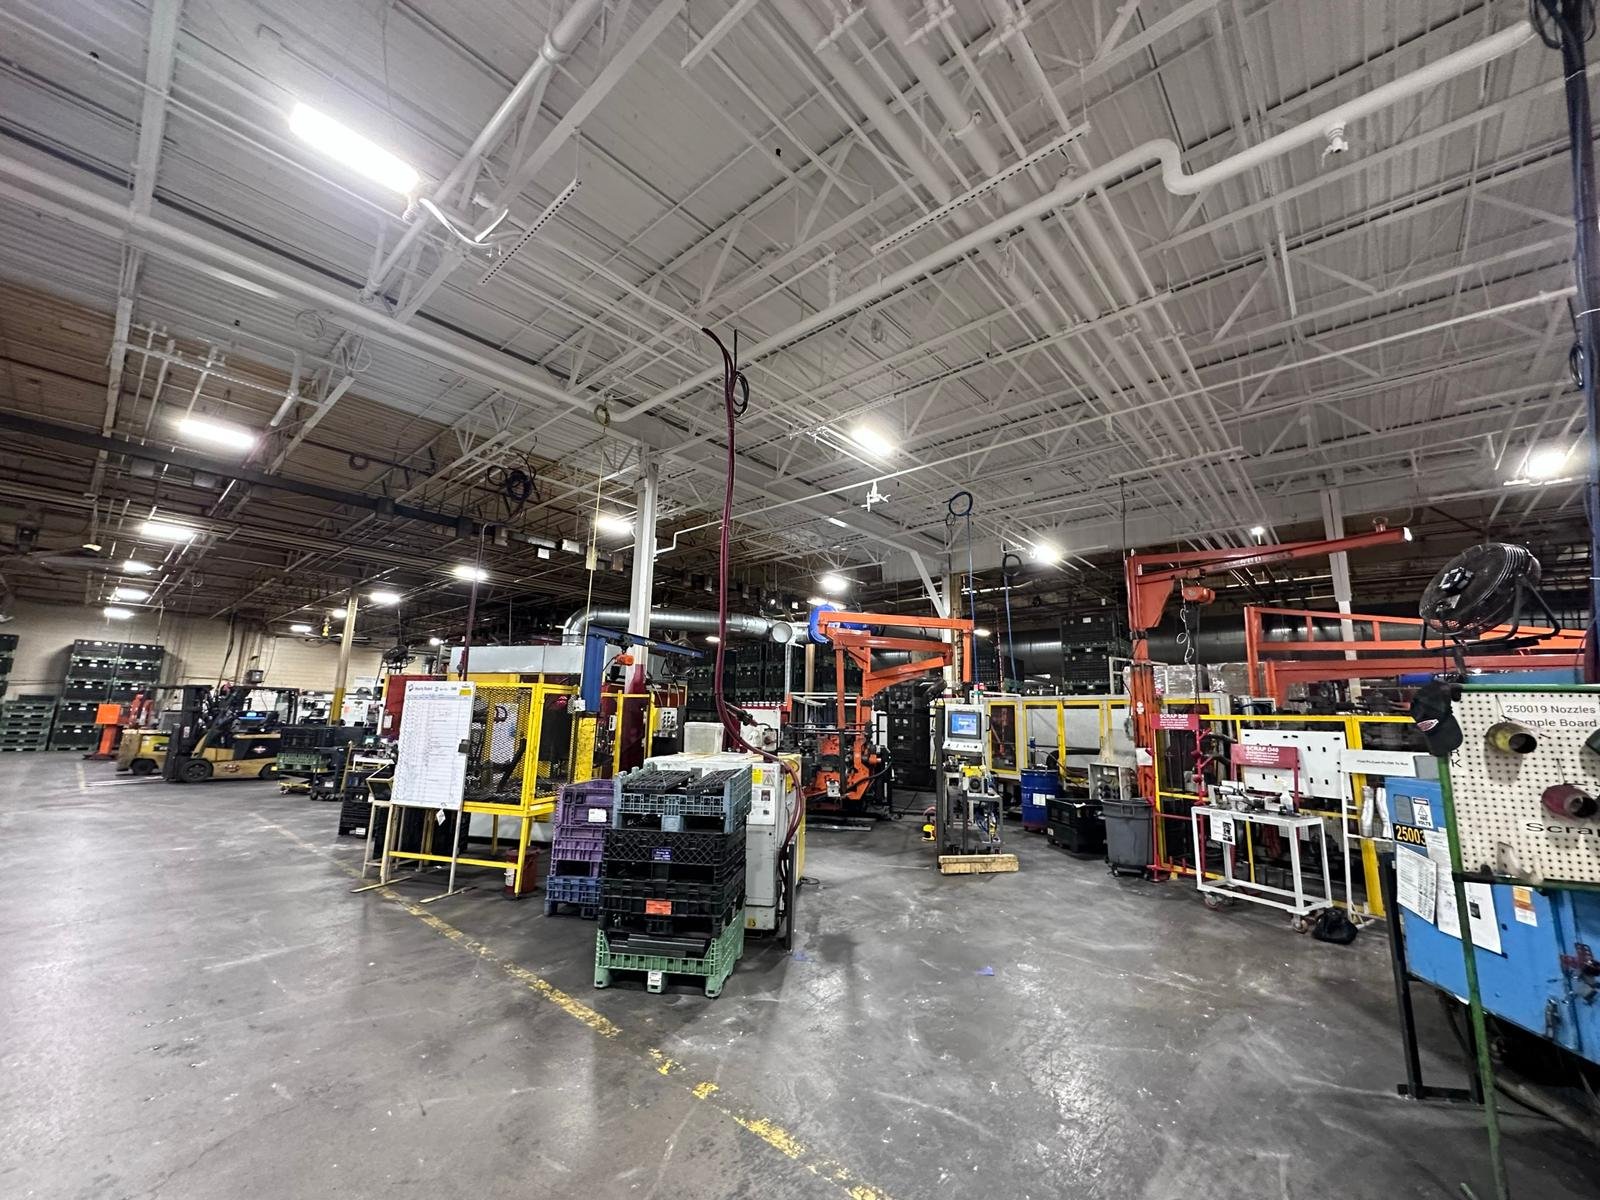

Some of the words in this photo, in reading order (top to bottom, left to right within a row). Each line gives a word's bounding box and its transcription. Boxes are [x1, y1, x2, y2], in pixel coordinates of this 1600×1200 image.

[1505, 705, 1548, 714] 250019
[1550, 705, 1597, 714] Nozzles
[1519, 718, 1556, 729] mple
[1559, 718, 1598, 728] Board
